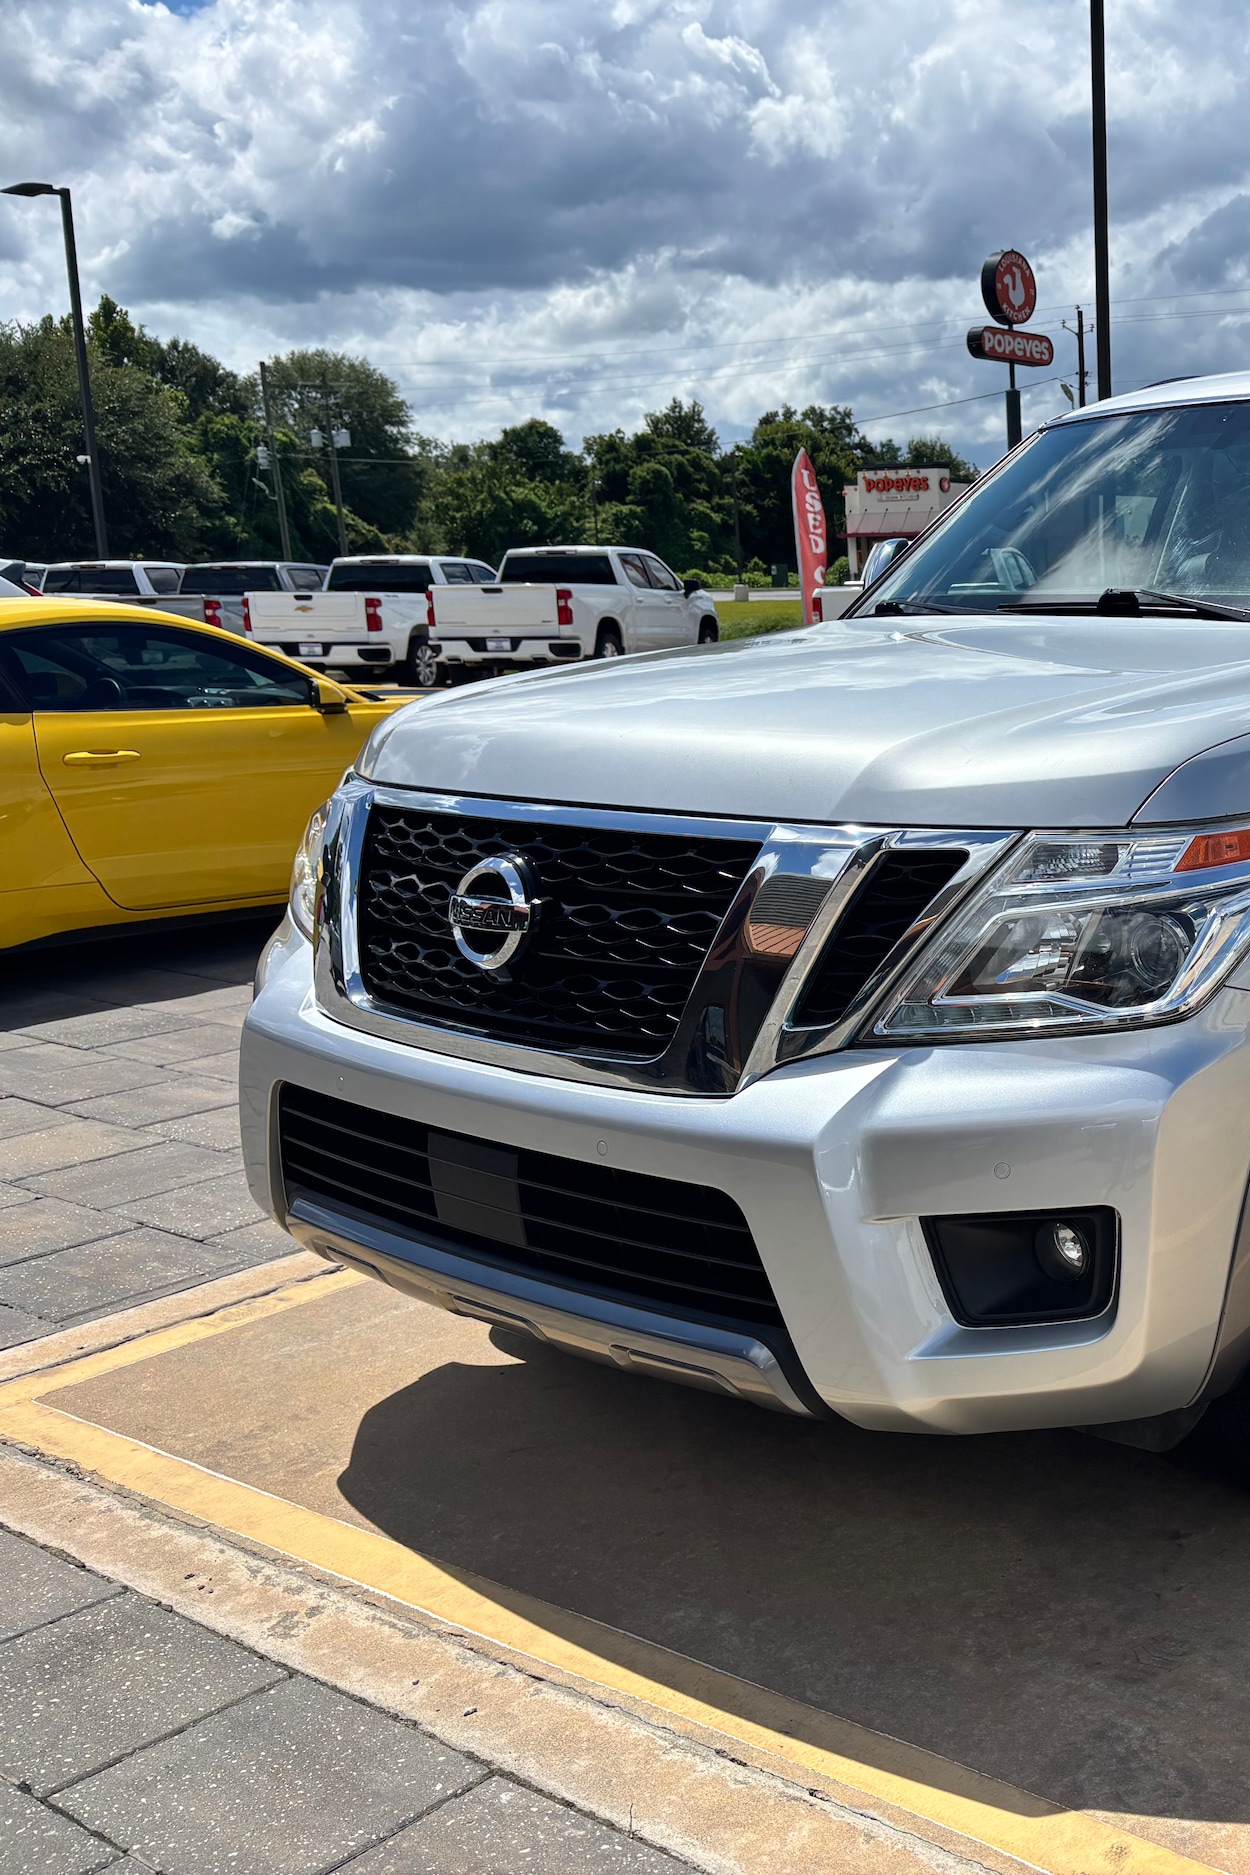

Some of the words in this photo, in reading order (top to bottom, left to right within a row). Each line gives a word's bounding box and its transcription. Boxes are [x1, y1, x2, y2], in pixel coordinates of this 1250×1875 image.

[1001, 302, 1032, 321] KITCHEN
[801, 469, 826, 554] USED
[451, 898, 514, 928] NISSAN
